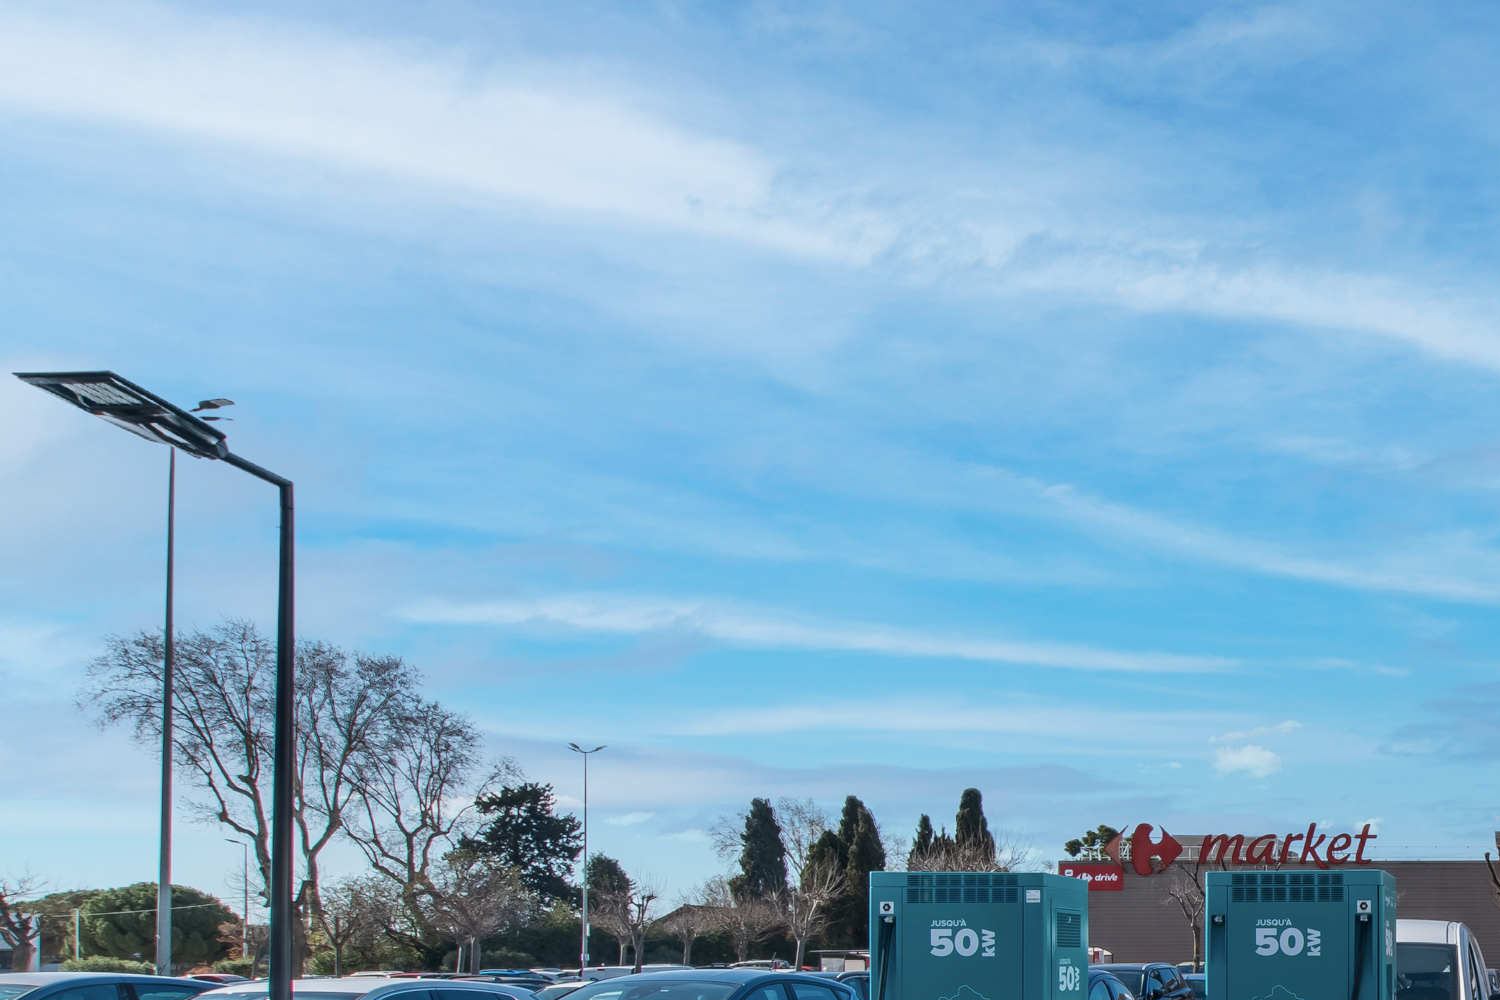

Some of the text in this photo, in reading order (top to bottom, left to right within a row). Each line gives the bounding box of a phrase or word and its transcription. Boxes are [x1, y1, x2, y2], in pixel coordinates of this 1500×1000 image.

[1198, 822, 1377, 869] market
[1094, 873, 1118, 882] drive
[930, 918, 967, 927] JUSQU'À
[1255, 917, 1293, 926] JUSQU'À
[929, 928, 996, 957] 50 kW
[1255, 927, 1321, 957] 50 kW
[1058, 965, 1075, 991] 50
